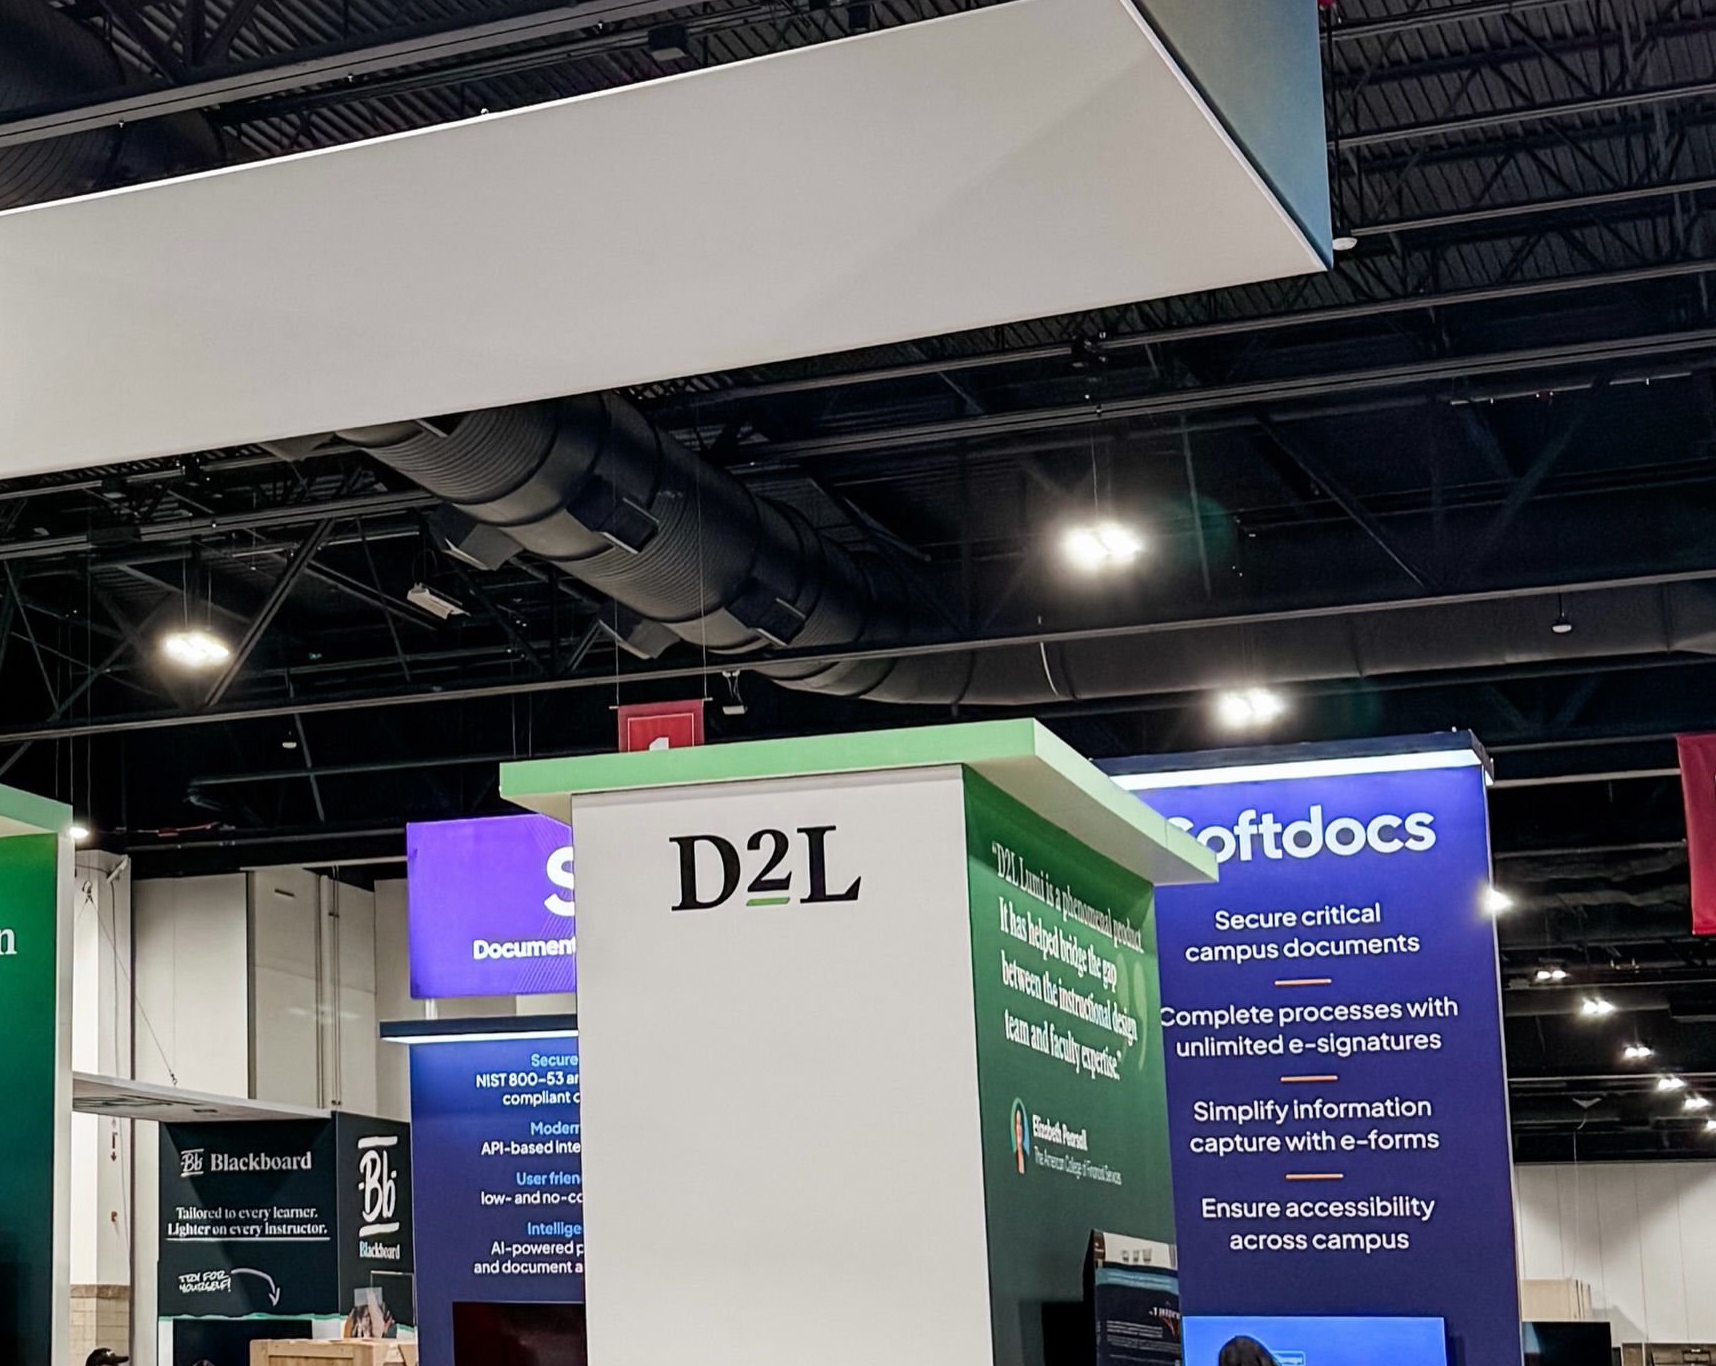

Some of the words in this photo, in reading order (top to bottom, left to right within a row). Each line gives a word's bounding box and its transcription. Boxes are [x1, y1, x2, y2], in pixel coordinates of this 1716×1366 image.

[669, 825, 861, 912] D2L
[1045, 873, 1054, 908] is
[1055, 892, 1062, 911] a
[1215, 909, 1298, 931] Secure
[1301, 902, 1381, 926] critical
[999, 896, 1009, 933] It
[1009, 901, 1027, 942] has
[1027, 911, 1059, 960] helped
[1059, 927, 1087, 978] bridge
[1087, 944, 1102, 979] the
[1102, 960, 1117, 993] gap
[1185, 941, 1279, 964] campus
[1283, 934, 1421, 958] documents
[1001, 950, 1042, 1001] between
[1043, 971, 1058, 1007] the
[1058, 978, 1111, 1030] instructional
[1112, 1001, 1138, 1046] design
[1160, 1004, 1274, 1029] Complete
[1278, 1001, 1402, 1027] processes
[1406, 996, 1458, 1018] with
[1005, 1009, 1030, 1047] team
[1031, 1020, 1049, 1054] and
[1050, 1022, 1080, 1074] faculty
[1176, 1034, 1284, 1058] unlimited
[1288, 1032, 1442, 1058] e-signatures
[531, 1054, 579, 1067] Secure
[476, 1073, 507, 1088] NIST
[502, 1090, 572, 1107] compliant
[1193, 1099, 1289, 1125] Simplify
[1292, 1097, 1432, 1120] information
[481, 1140, 553, 1156] API-based
[1189, 1135, 1282, 1156] capture
[1285, 1131, 1336, 1152] with
[1340, 1129, 1440, 1151] e-forms
[210, 1151, 312, 1171] Blackboard
[516, 1172, 547, 1185] User
[514, 1190, 541, 1204] and
[176, 1207, 222, 1220] Tailored
[224, 1208, 236, 1219] to
[238, 1209, 270, 1222] every
[273, 1206, 318, 1219] learner.
[1201, 1197, 1281, 1219] Ensure
[1285, 1196, 1435, 1221] accessibility
[167, 1223, 211, 1236] Lighter
[212, 1226, 227, 1235] on
[230, 1226, 262, 1237] every
[359, 1241, 400, 1260] Blackboard
[491, 1241, 574, 1257] AI-powered
[1230, 1233, 1308, 1251] across
[1312, 1232, 1409, 1254] campus
[203, 1270, 229, 1281] FOR
[474, 1260, 499, 1274] and
[502, 1260, 572, 1274] document
